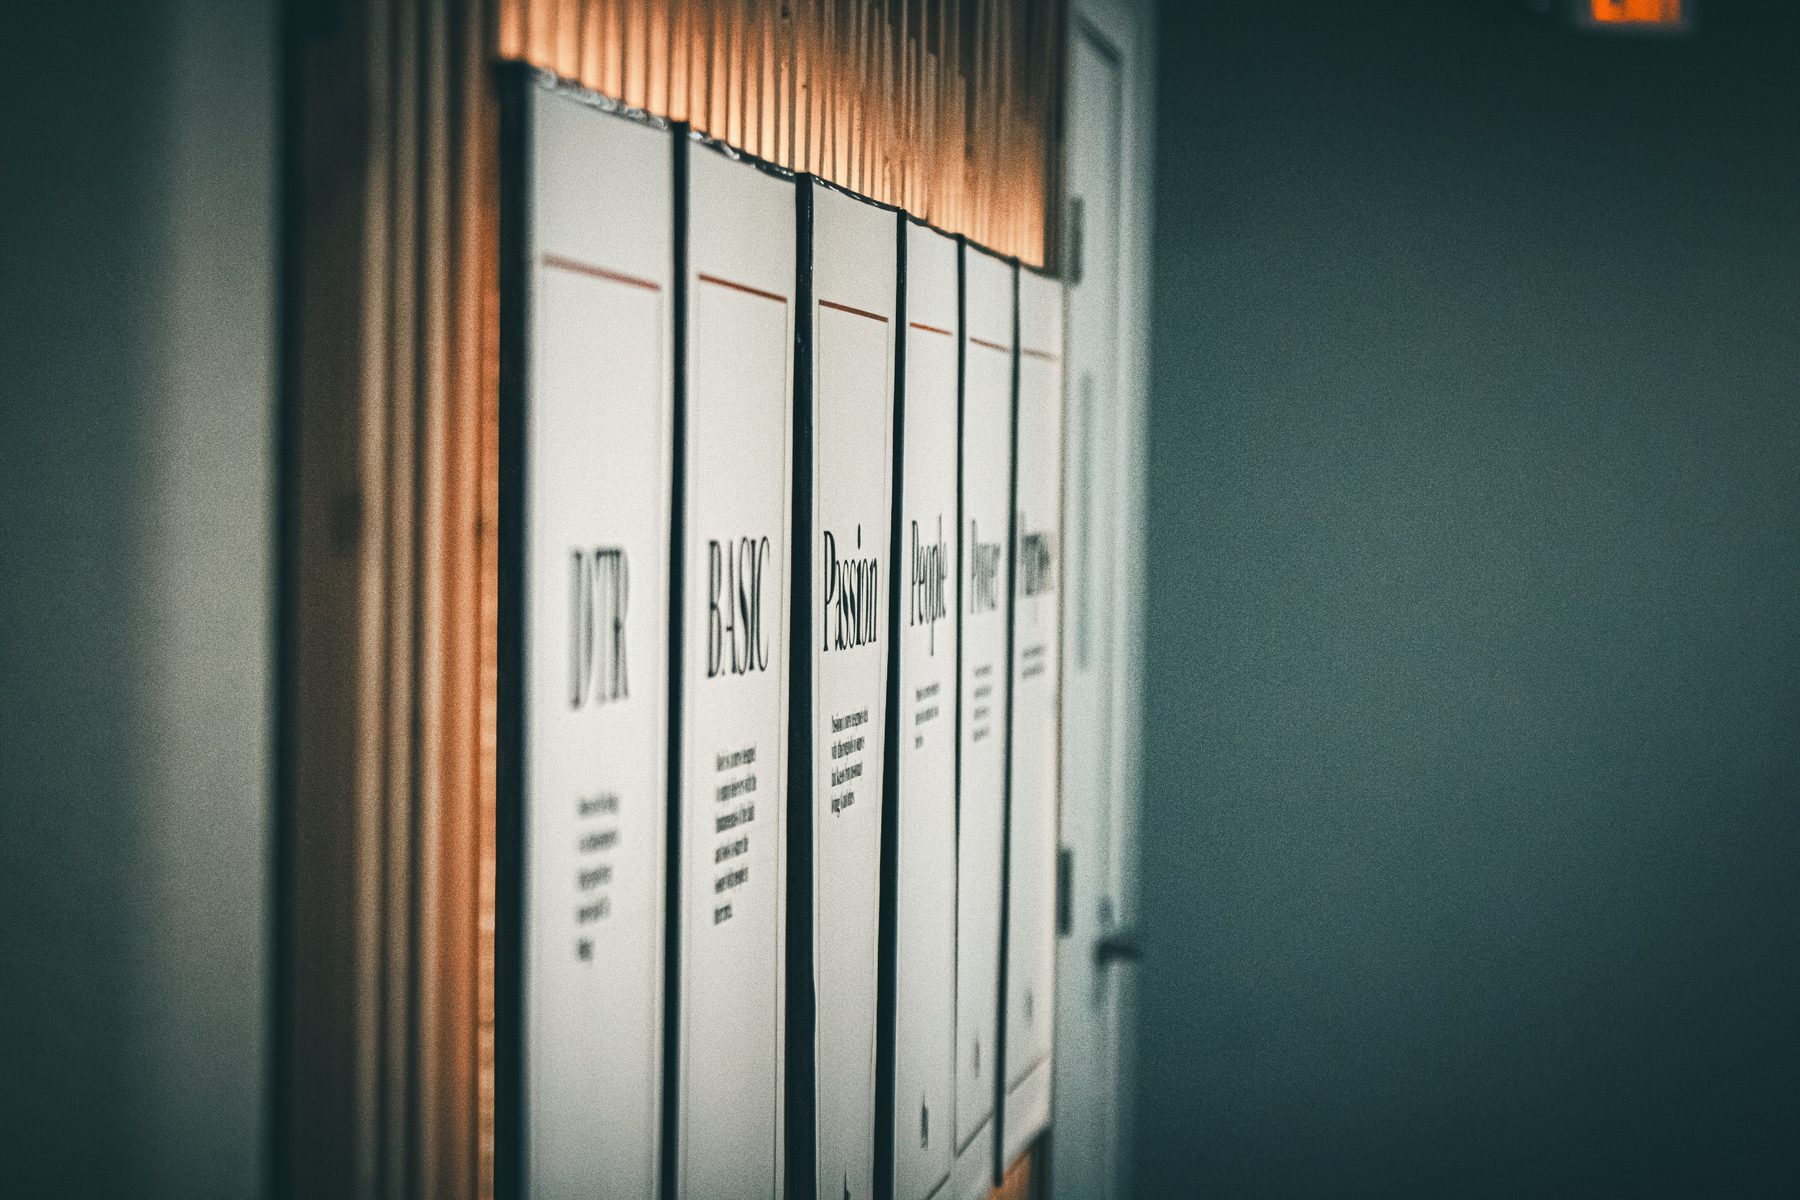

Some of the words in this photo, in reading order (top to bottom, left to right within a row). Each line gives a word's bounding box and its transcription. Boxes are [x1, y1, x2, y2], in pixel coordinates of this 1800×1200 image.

[707, 535, 770, 679] BASIC
[823, 523, 878, 652] Passion
[910, 512, 948, 656] People
